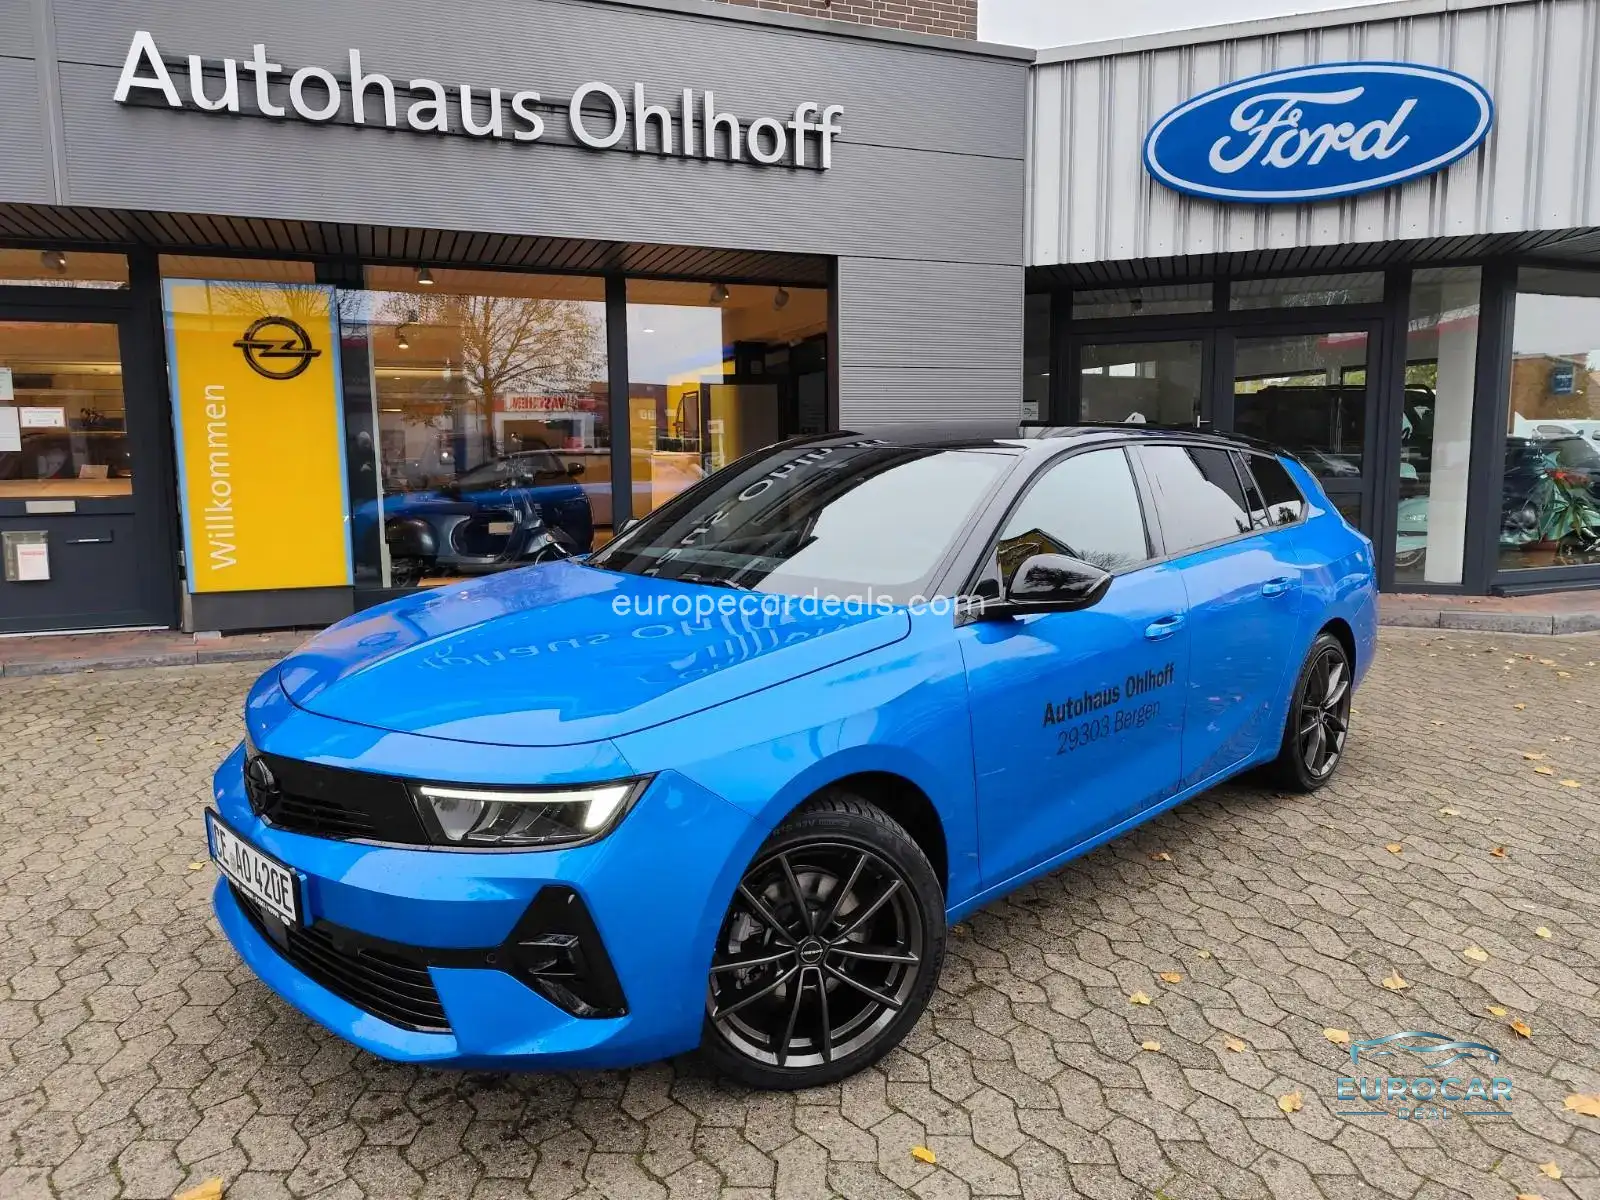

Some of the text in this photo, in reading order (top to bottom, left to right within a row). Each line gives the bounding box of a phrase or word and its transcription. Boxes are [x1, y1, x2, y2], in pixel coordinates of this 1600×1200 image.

[114, 30, 845, 171] Autohaus Ohlhoff
[1208, 86, 1418, 174] Ford
[204, 384, 237, 570] Willkommen
[1043, 662, 1175, 728] Autohaus Ohlhoff
[1056, 700, 1160, 755] 29303 Bergen
[214, 824, 229, 866] CE
[234, 841, 251, 883] AO
[254, 857, 292, 912] 420E
